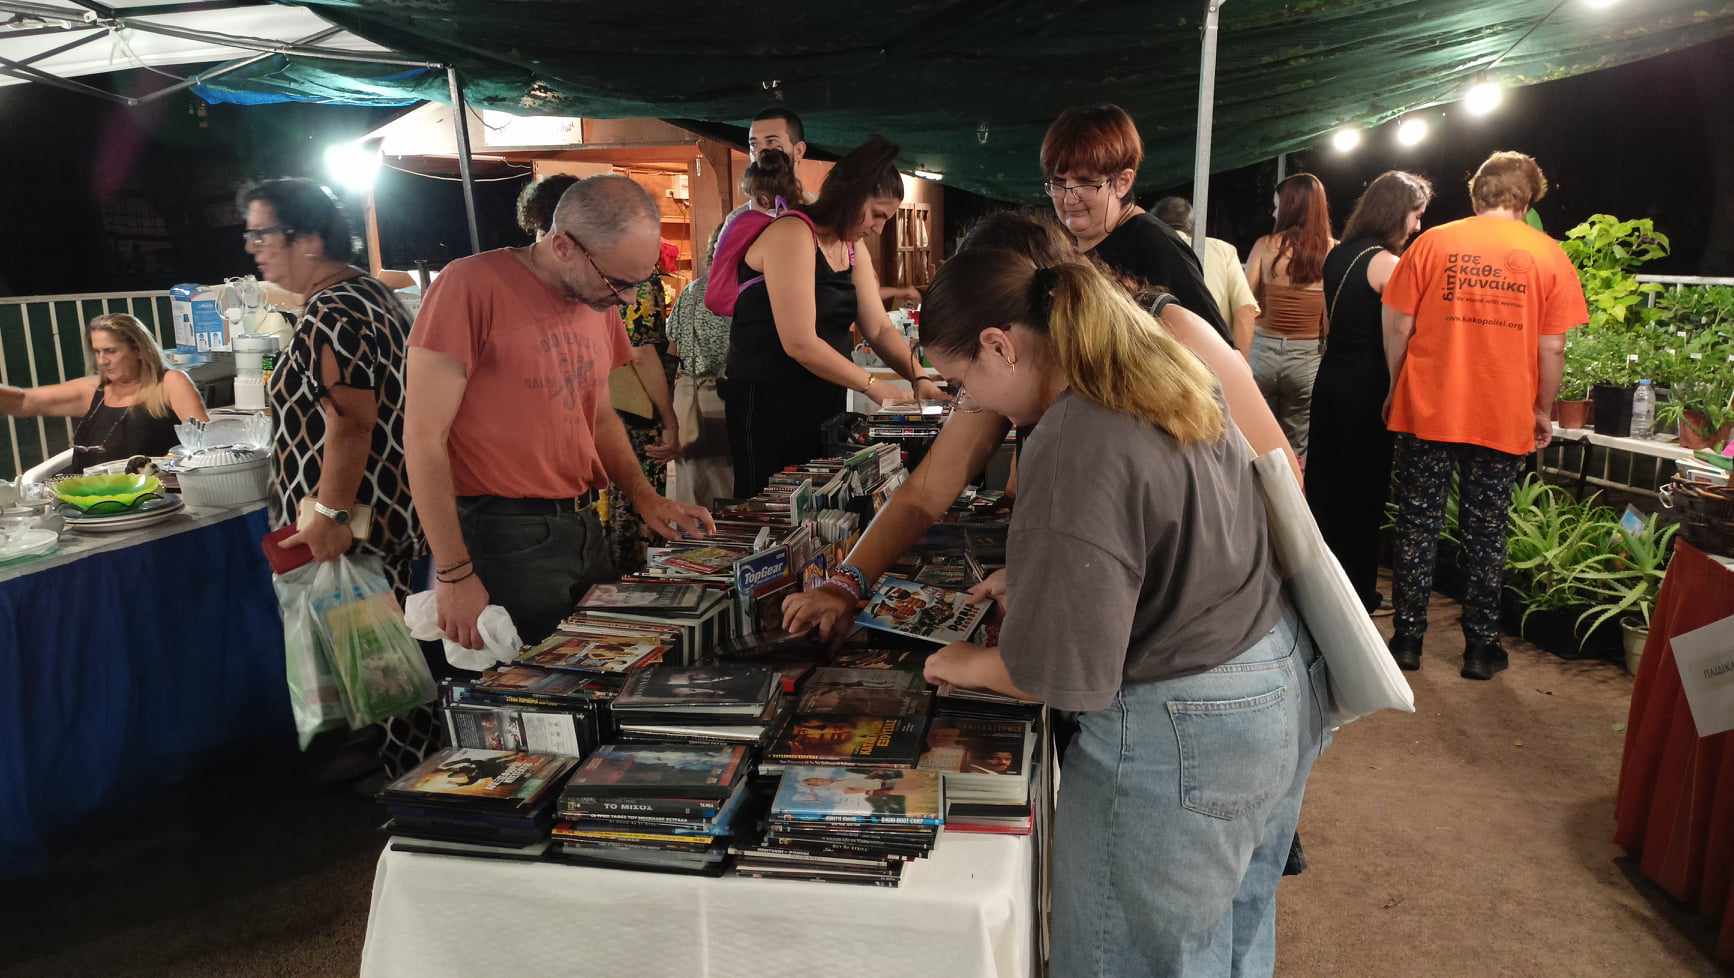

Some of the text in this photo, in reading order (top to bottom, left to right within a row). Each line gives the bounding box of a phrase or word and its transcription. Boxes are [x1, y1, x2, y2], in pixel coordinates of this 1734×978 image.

[1461, 254, 1481, 265] σε
[1458, 276, 1527, 294] γυναίκα
[744, 562, 784, 585] TopGear
[603, 802, 617, 810] ΤΟ
